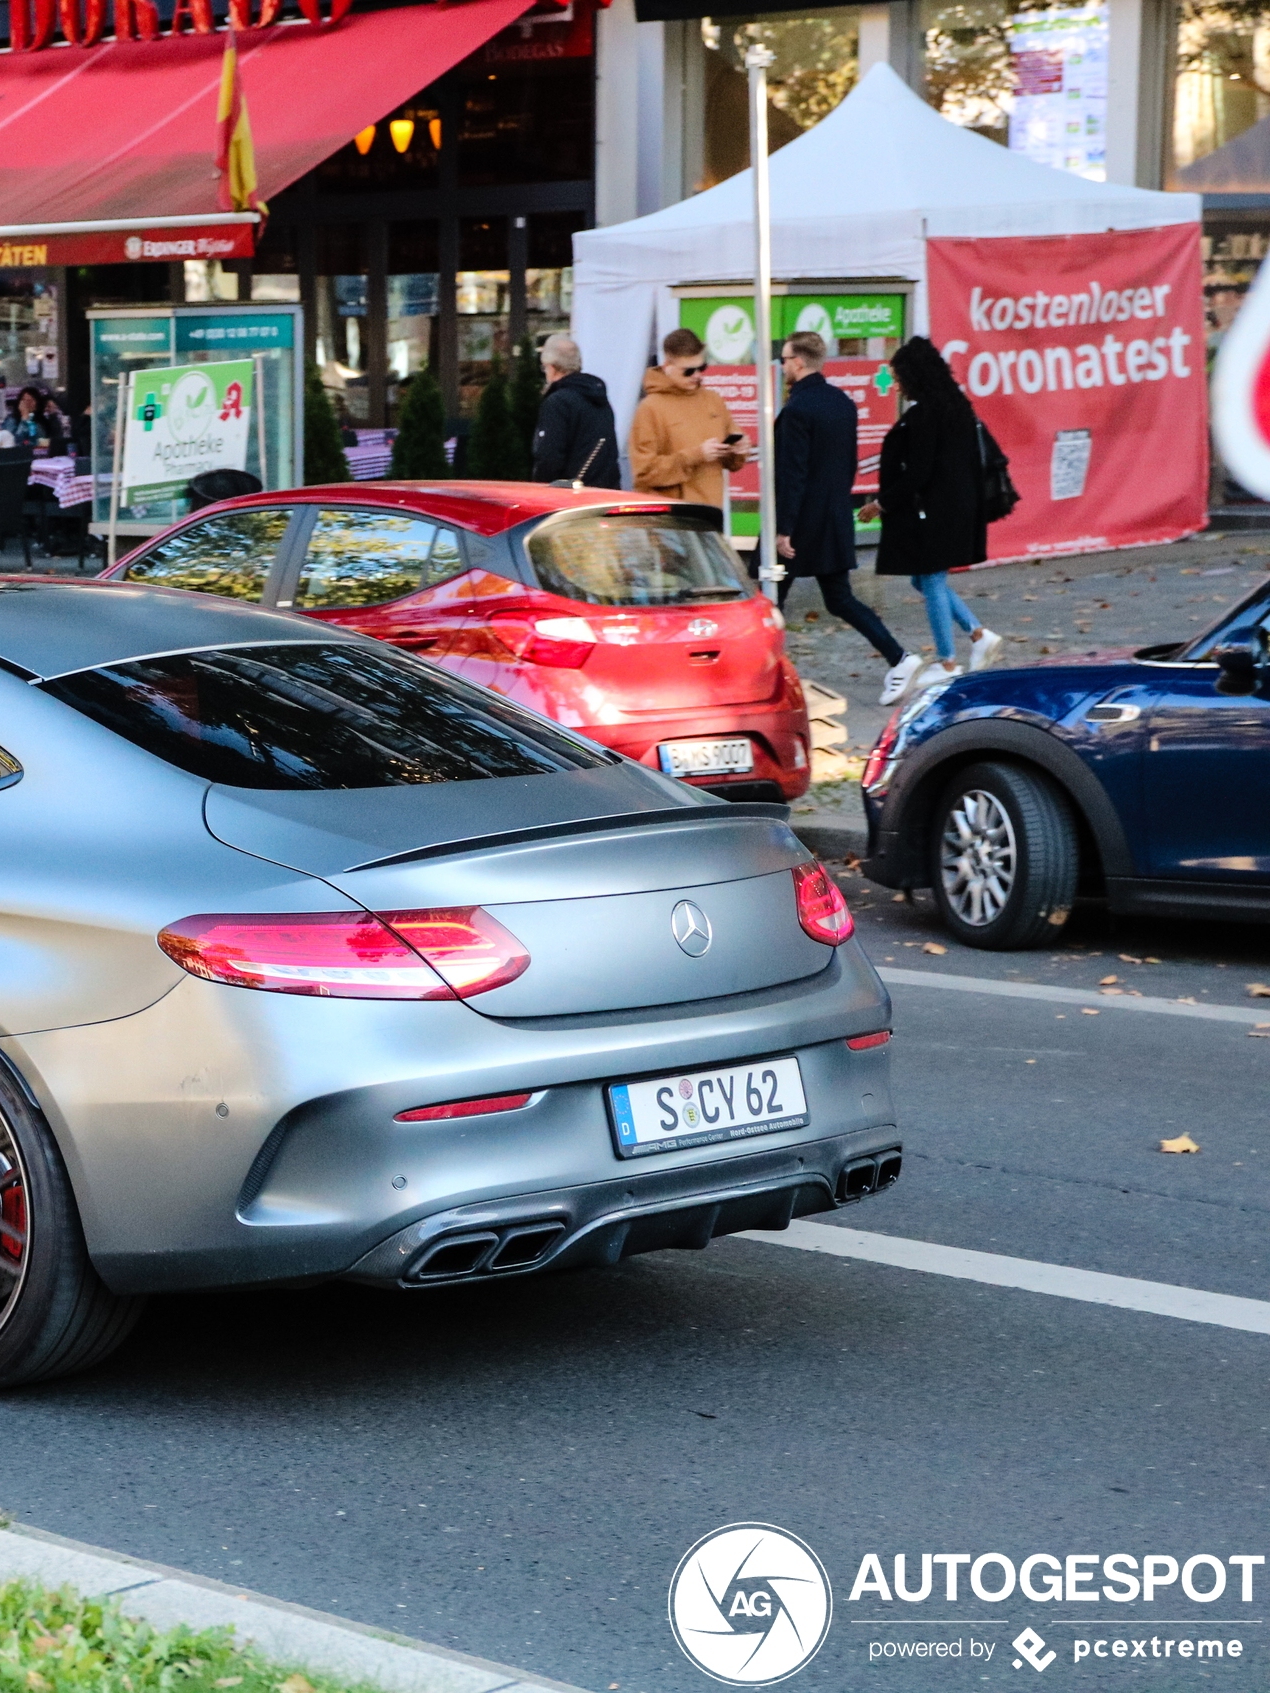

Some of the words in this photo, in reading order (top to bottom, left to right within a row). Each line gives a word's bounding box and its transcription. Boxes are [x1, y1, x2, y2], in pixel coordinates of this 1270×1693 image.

[835, 303, 892, 328] Apotheke
[970, 280, 1171, 332] kostenloser
[153, 434, 224, 462] Apotheke
[656, 1086, 679, 1132] S
[697, 1075, 736, 1124] CY
[746, 1069, 784, 1116] 62
[621, 1122, 631, 1136] D
[645, 1139, 677, 1152] AMG
[679, 1134, 708, 1146] Performance
[708, 1131, 724, 1142] Center
[730, 1124, 768, 1138] Nord-Ostsee
